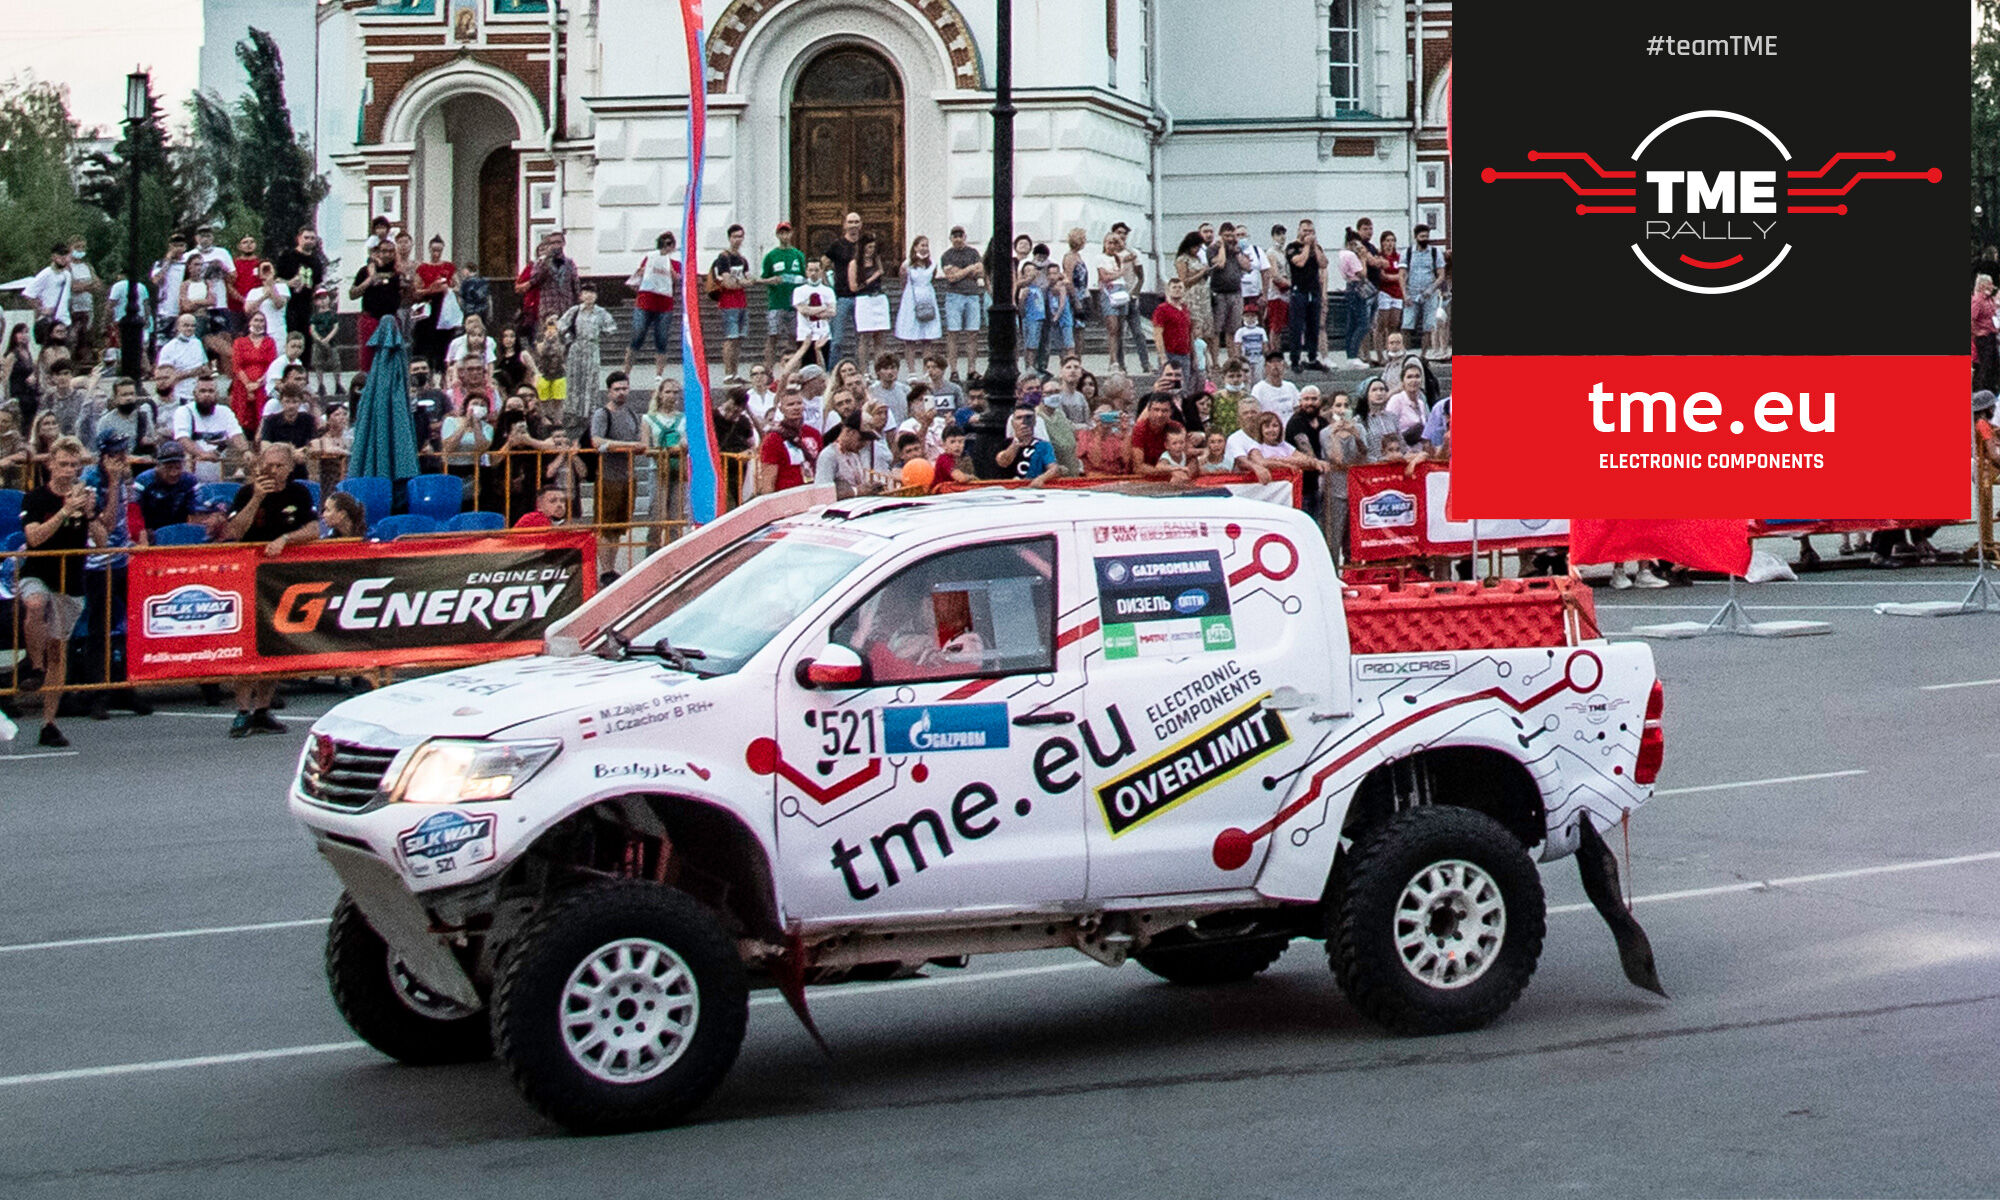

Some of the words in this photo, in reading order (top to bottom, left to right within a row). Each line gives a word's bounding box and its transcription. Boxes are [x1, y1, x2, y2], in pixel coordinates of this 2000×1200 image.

[1113, 533, 1138, 542] WAY
[466, 571, 537, 585] ENGINE
[540, 568, 571, 580] OIL
[1131, 560, 1212, 577] GAZPROMBANK
[155, 603, 194, 616] SILK
[195, 601, 231, 613] WAY
[1146, 659, 1242, 723] ELECTRONIC
[673, 705, 685, 718] B
[687, 700, 714, 715] RH+
[1154, 669, 1262, 741] COMPONENTS
[1588, 703, 1606, 712] TME
[822, 709, 877, 756] 521
[932, 731, 987, 749] GAZPROM
[1114, 708, 1272, 818] OVERLIMIT
[830, 703, 1137, 901] tme.eu
[406, 830, 443, 855] SILK
[443, 821, 484, 843] WAY
[435, 856, 457, 874] 521
